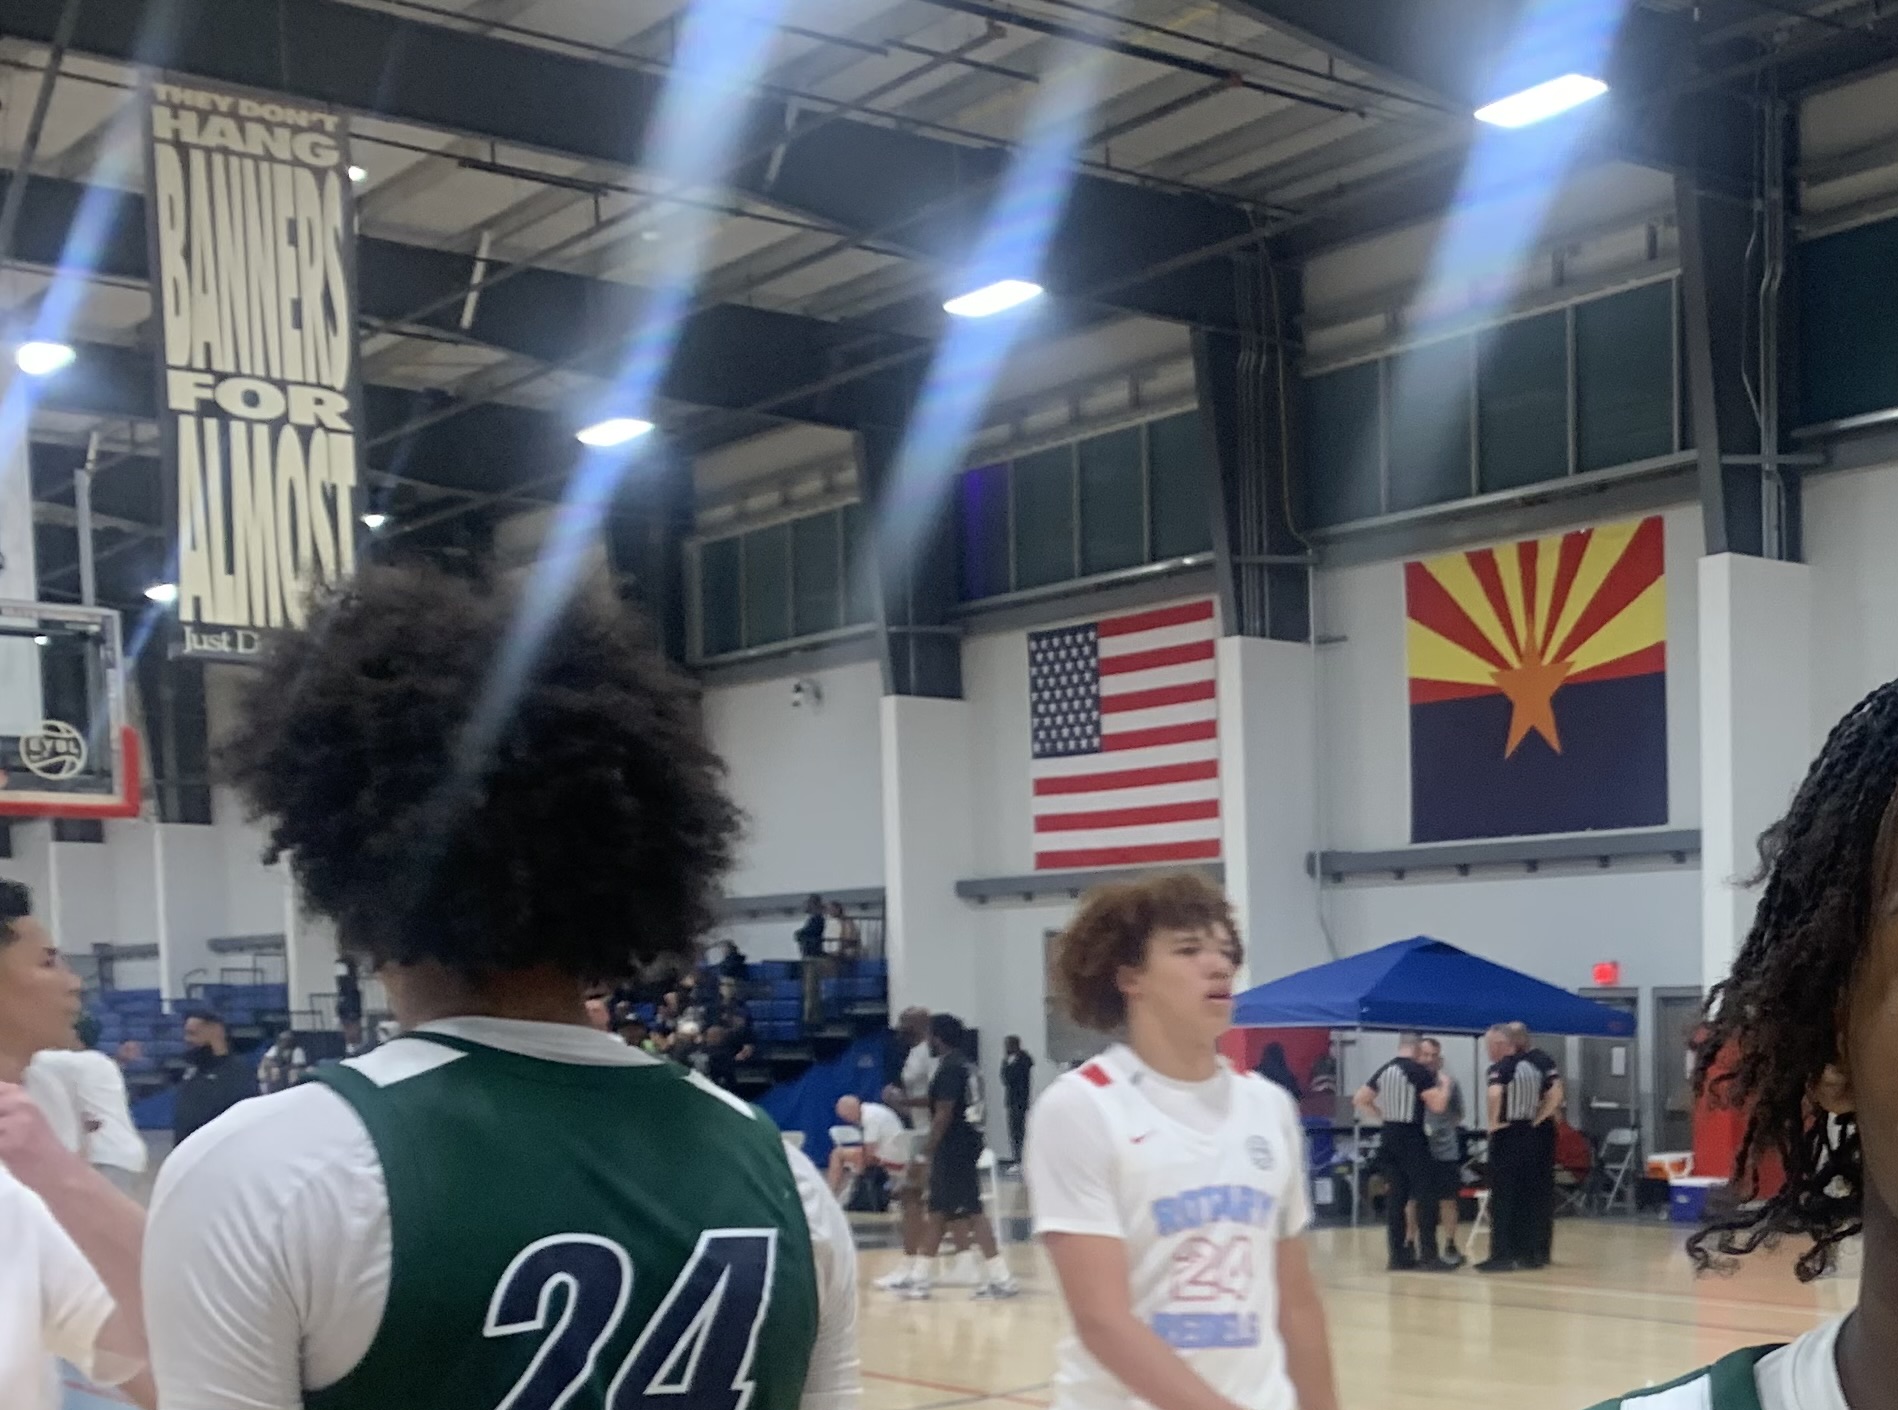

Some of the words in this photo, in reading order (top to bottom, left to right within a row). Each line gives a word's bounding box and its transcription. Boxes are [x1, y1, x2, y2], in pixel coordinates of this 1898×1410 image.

[153, 84, 235, 112] THEY
[152, 105, 340, 168] HANG
[154, 142, 349, 391] BANNERS
[167, 369, 354, 432] FOR
[178, 414, 356, 631] ALMOST
[184, 626, 230, 654] Just
[1168, 1235, 1253, 1301] 24
